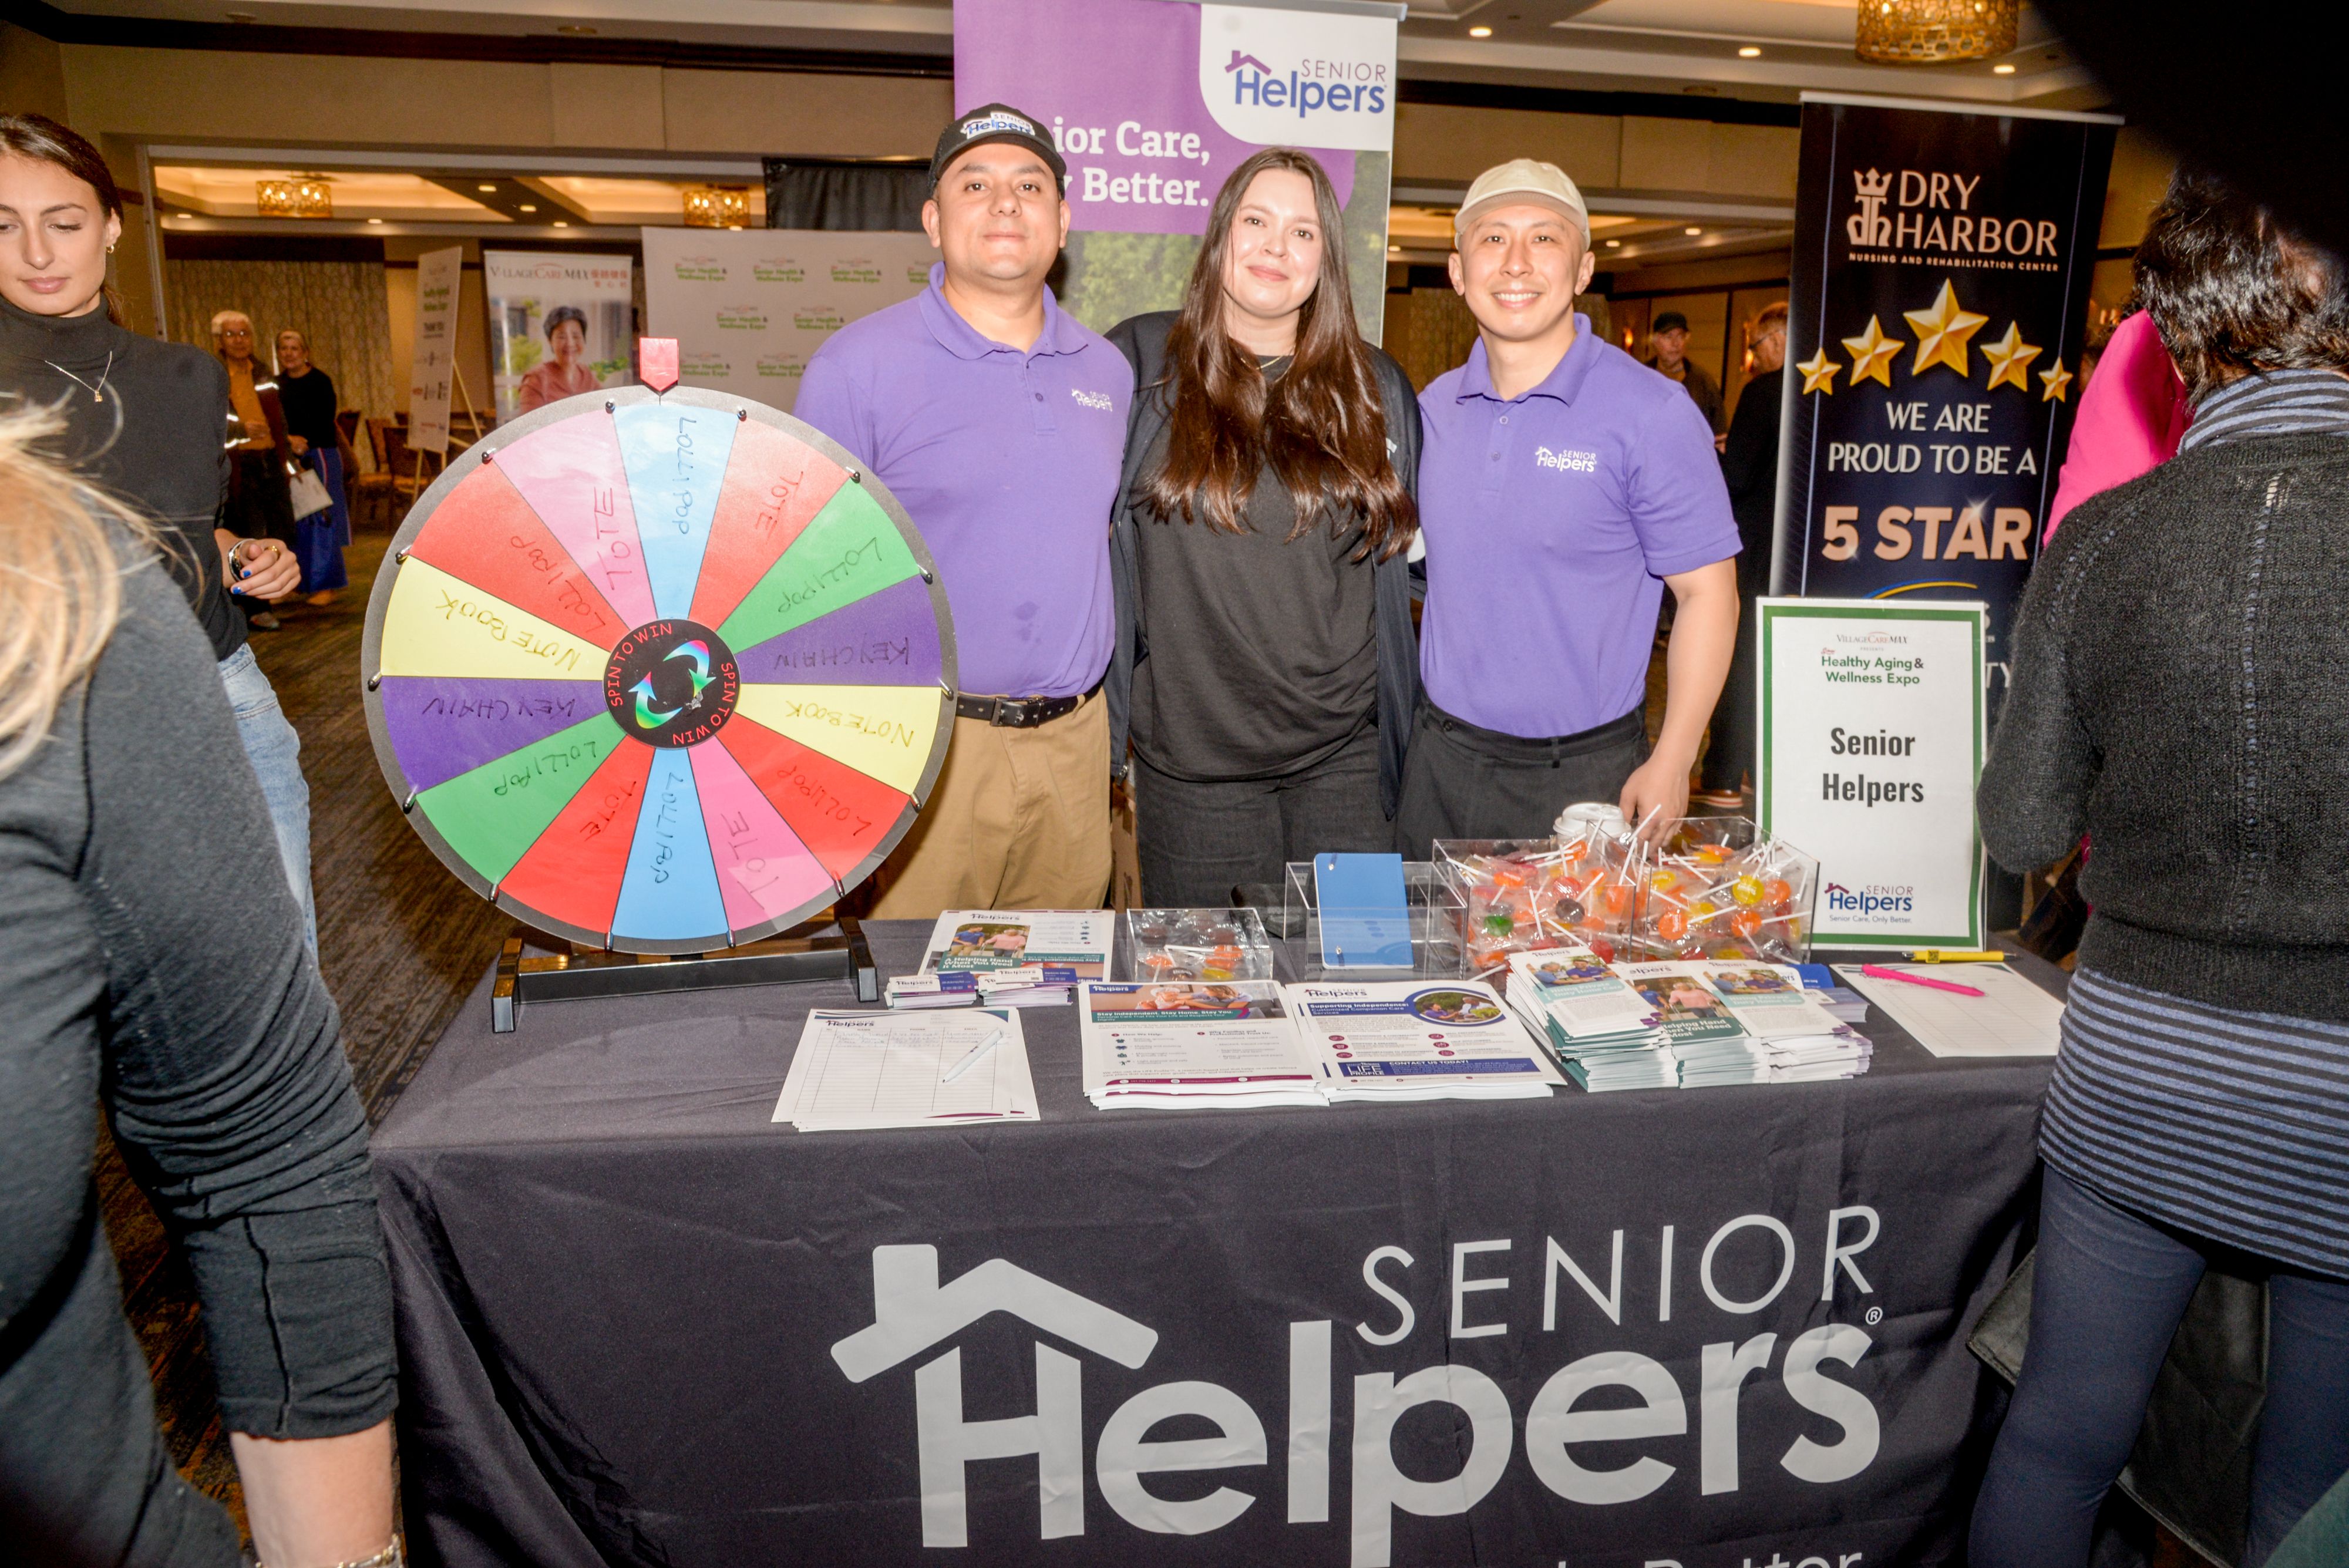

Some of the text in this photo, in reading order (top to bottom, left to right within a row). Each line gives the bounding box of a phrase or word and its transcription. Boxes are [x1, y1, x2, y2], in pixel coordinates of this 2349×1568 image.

[1235, 69, 1386, 119] Helpers
[1301, 59, 1386, 83] SENIOR
[969, 119, 1031, 135] Helpers
[1055, 116, 1210, 166] ior Care,
[1082, 168, 1209, 207] Better.
[1899, 170, 1981, 210] DRY
[1896, 213, 2059, 257] HARBOR
[1849, 253, 2058, 272] NURSING AND REHABILITATION CENTER
[1886, 401, 1992, 433] WE ARE
[672, 415, 697, 534] LOLLIPOP
[1536, 453, 1595, 472] Helpers
[1562, 449, 1596, 461] SENIOR
[1828, 442, 2037, 475] PROUD TO BE A
[755, 470, 805, 545] TOTE
[593, 487, 632, 591] TOTE
[1821, 506, 2032, 561] 5 STAR
[510, 535, 606, 634] LOLLIPOP
[777, 537, 882, 613] LOLLIPOP
[608, 623, 673, 706] SPIN TO WIN
[1821, 655, 1924, 671] Healthy Aging &
[1826, 671, 1920, 687] Wellness Expo
[672, 662, 736, 745] SPIN TO WIN
[1830, 727, 1916, 756] Senior
[494, 741, 597, 796] LOLLIPOP
[1822, 773, 1924, 808] Helpers
[580, 780, 638, 842] TOTE
[776, 765, 872, 837] LOLLIPOP
[649, 772, 684, 884] LOLLIPOP
[721, 810, 779, 910] TOTE
[1829, 891, 1913, 915] Helpers
[1866, 885, 1914, 895] SENIOR
[1872, 916, 1888, 924] Only
[1357, 1204, 1882, 1347] SENIOR
[914, 1318, 1882, 1568] Helpers
